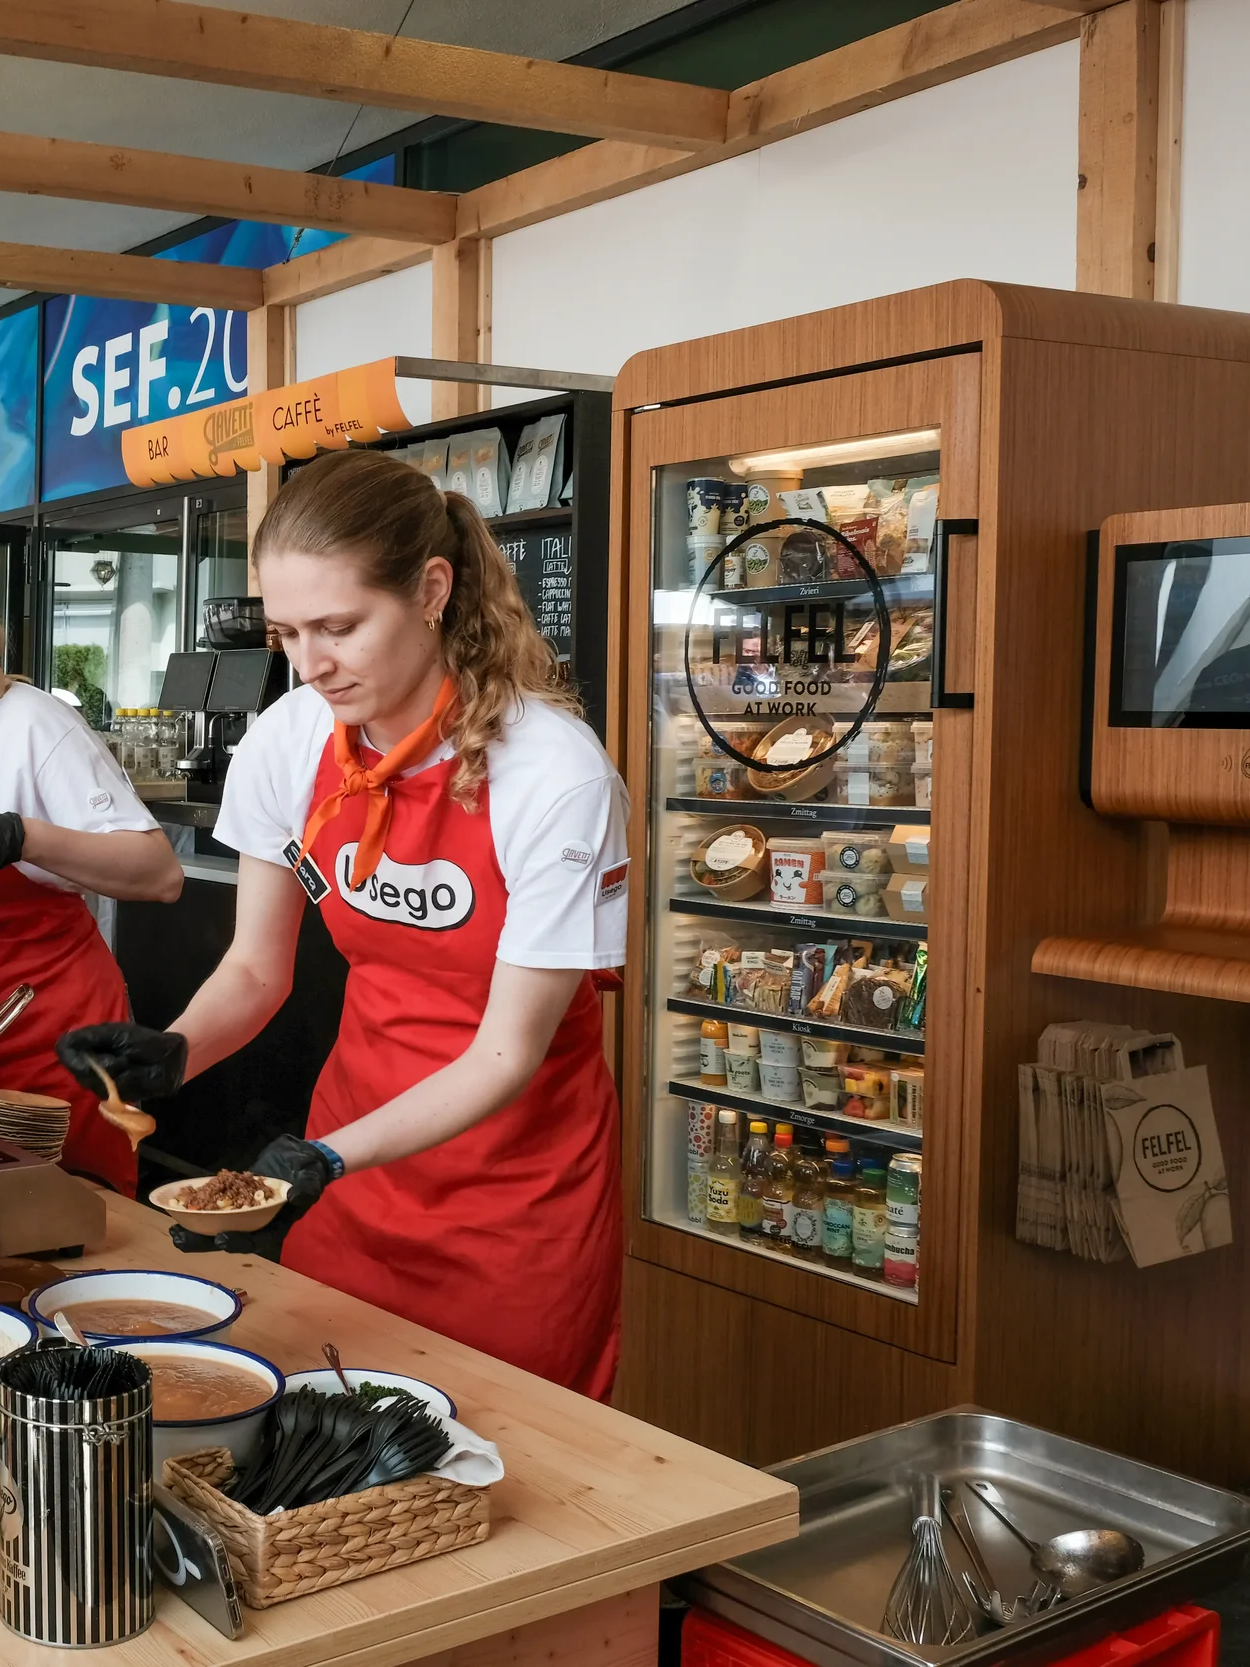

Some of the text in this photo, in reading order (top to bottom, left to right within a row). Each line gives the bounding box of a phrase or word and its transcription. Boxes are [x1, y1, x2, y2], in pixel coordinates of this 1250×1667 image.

[272, 392, 324, 432] CAFFÈ
[324, 419, 364, 437] by FELFEL
[147, 435, 169, 461] BAR
[498, 538, 527, 561] AFFÈ
[799, 586, 820, 597] Zvieri
[713, 602, 856, 665] FELFEL
[732, 681, 832, 696] GOOD FOOD
[744, 702, 818, 717] AT WORK
[790, 807, 817, 819] Zmittag
[344, 854, 457, 920] Usego
[601, 884, 623, 897] Usego
[789, 915, 816, 927] Zmittag
[790, 970, 803, 1001] OAT BAR
[792, 1023, 811, 1034] Kiosk
[789, 1111, 815, 1125] Zmorge
[1142, 1130, 1192, 1159] FELFEL
[1170, 1156, 1188, 1165] FOOD
[1165, 1165, 1184, 1173] WORK
[708, 1184, 729, 1197] Yuzu
[708, 1194, 729, 1206] Soda
[6, 1558, 26, 1581] Kaffee
